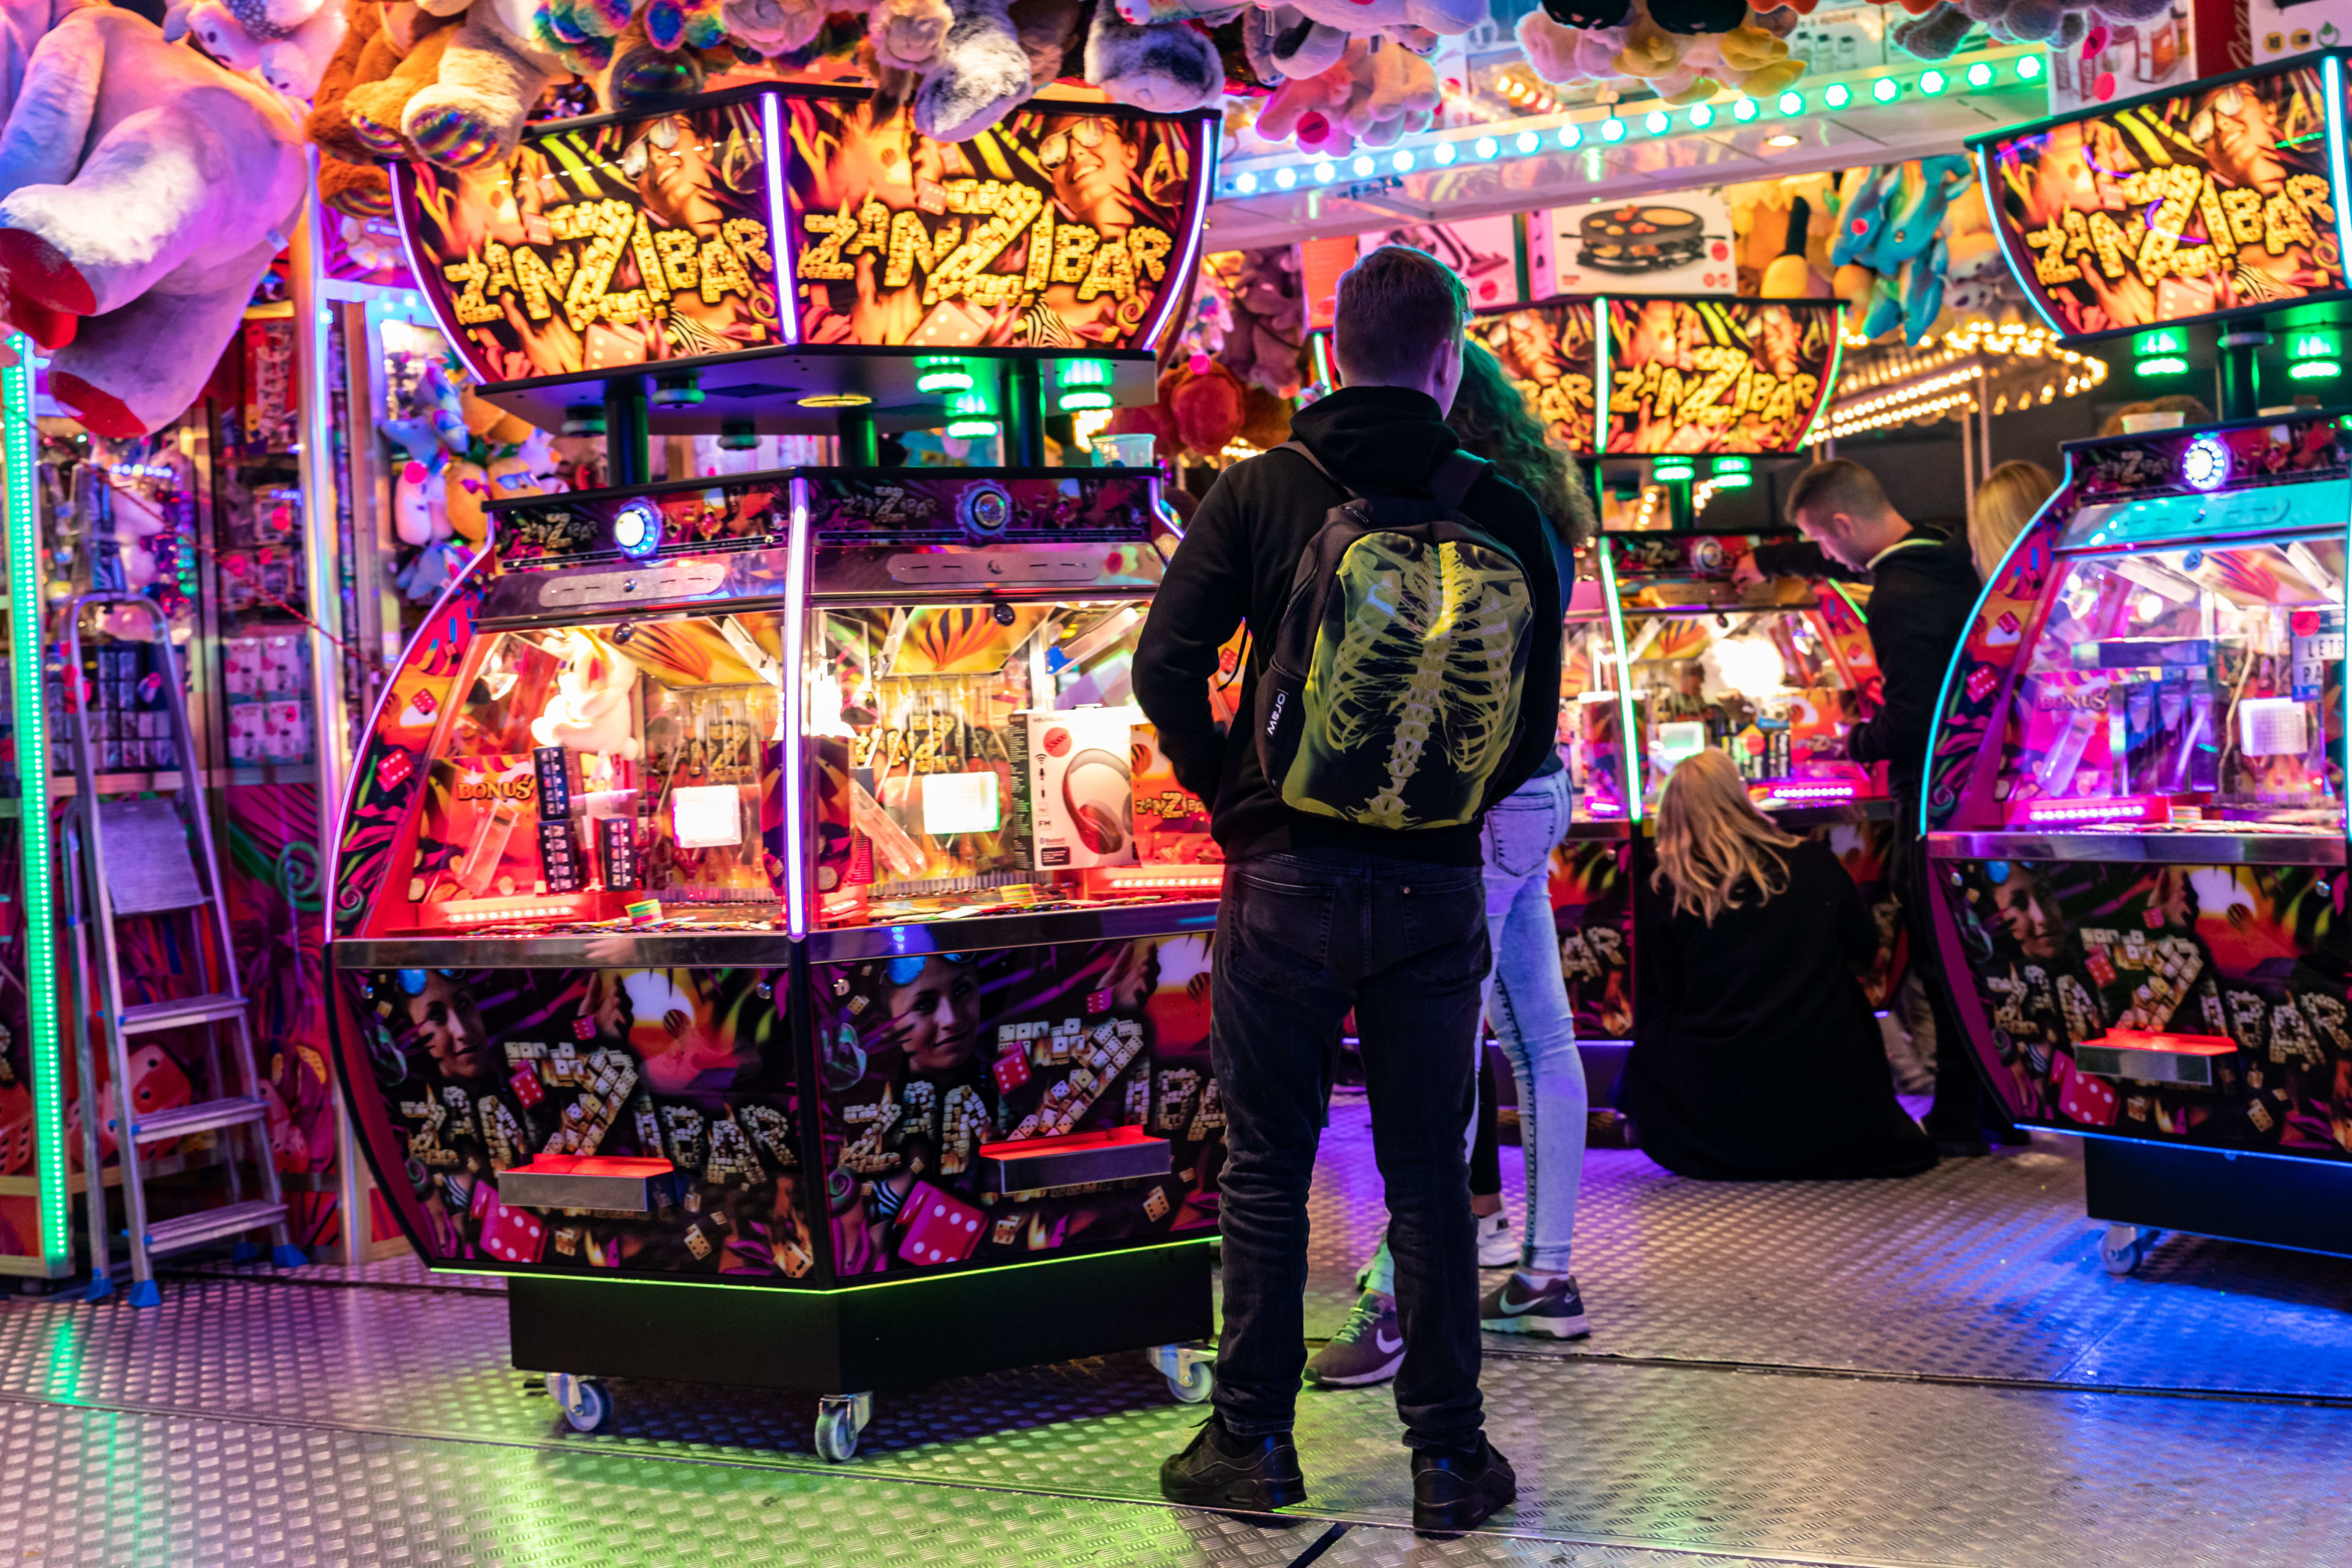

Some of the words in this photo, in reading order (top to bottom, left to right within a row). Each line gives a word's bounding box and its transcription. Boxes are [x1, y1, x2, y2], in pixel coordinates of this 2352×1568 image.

[444, 197, 773, 332] ZANZIBAR
[797, 178, 1172, 306] ZANZIBAR
[2026, 163, 2335, 286] ZANZIBAR
[1609, 346, 1818, 427] ZANZIBAR
[458, 780, 532, 802] BONUS
